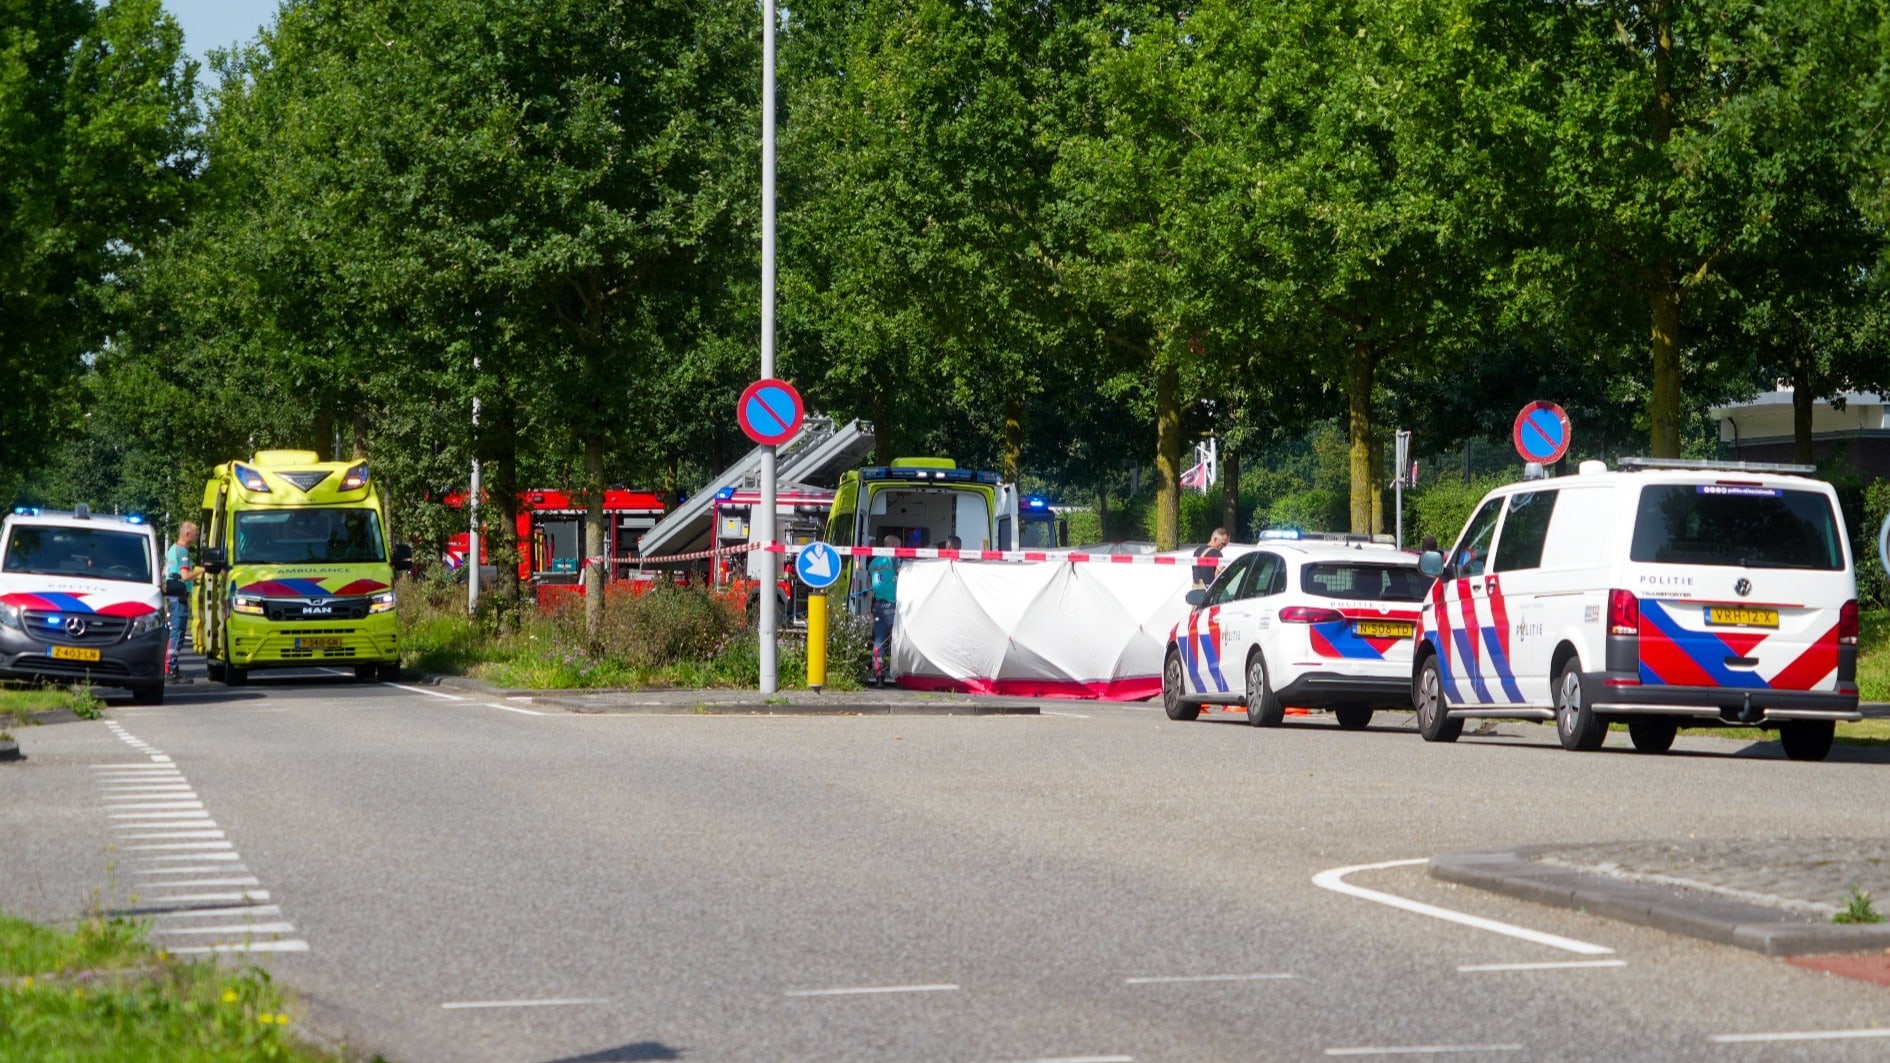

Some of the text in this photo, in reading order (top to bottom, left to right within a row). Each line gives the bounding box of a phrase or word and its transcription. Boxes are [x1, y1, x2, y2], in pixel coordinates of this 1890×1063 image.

[1640, 575, 1693, 586] POLITIE
[1716, 608, 1771, 623] VRH-12-X
[1360, 623, 1409, 635] N-506-TD
[54, 647, 97, 659] Z-403-LN
